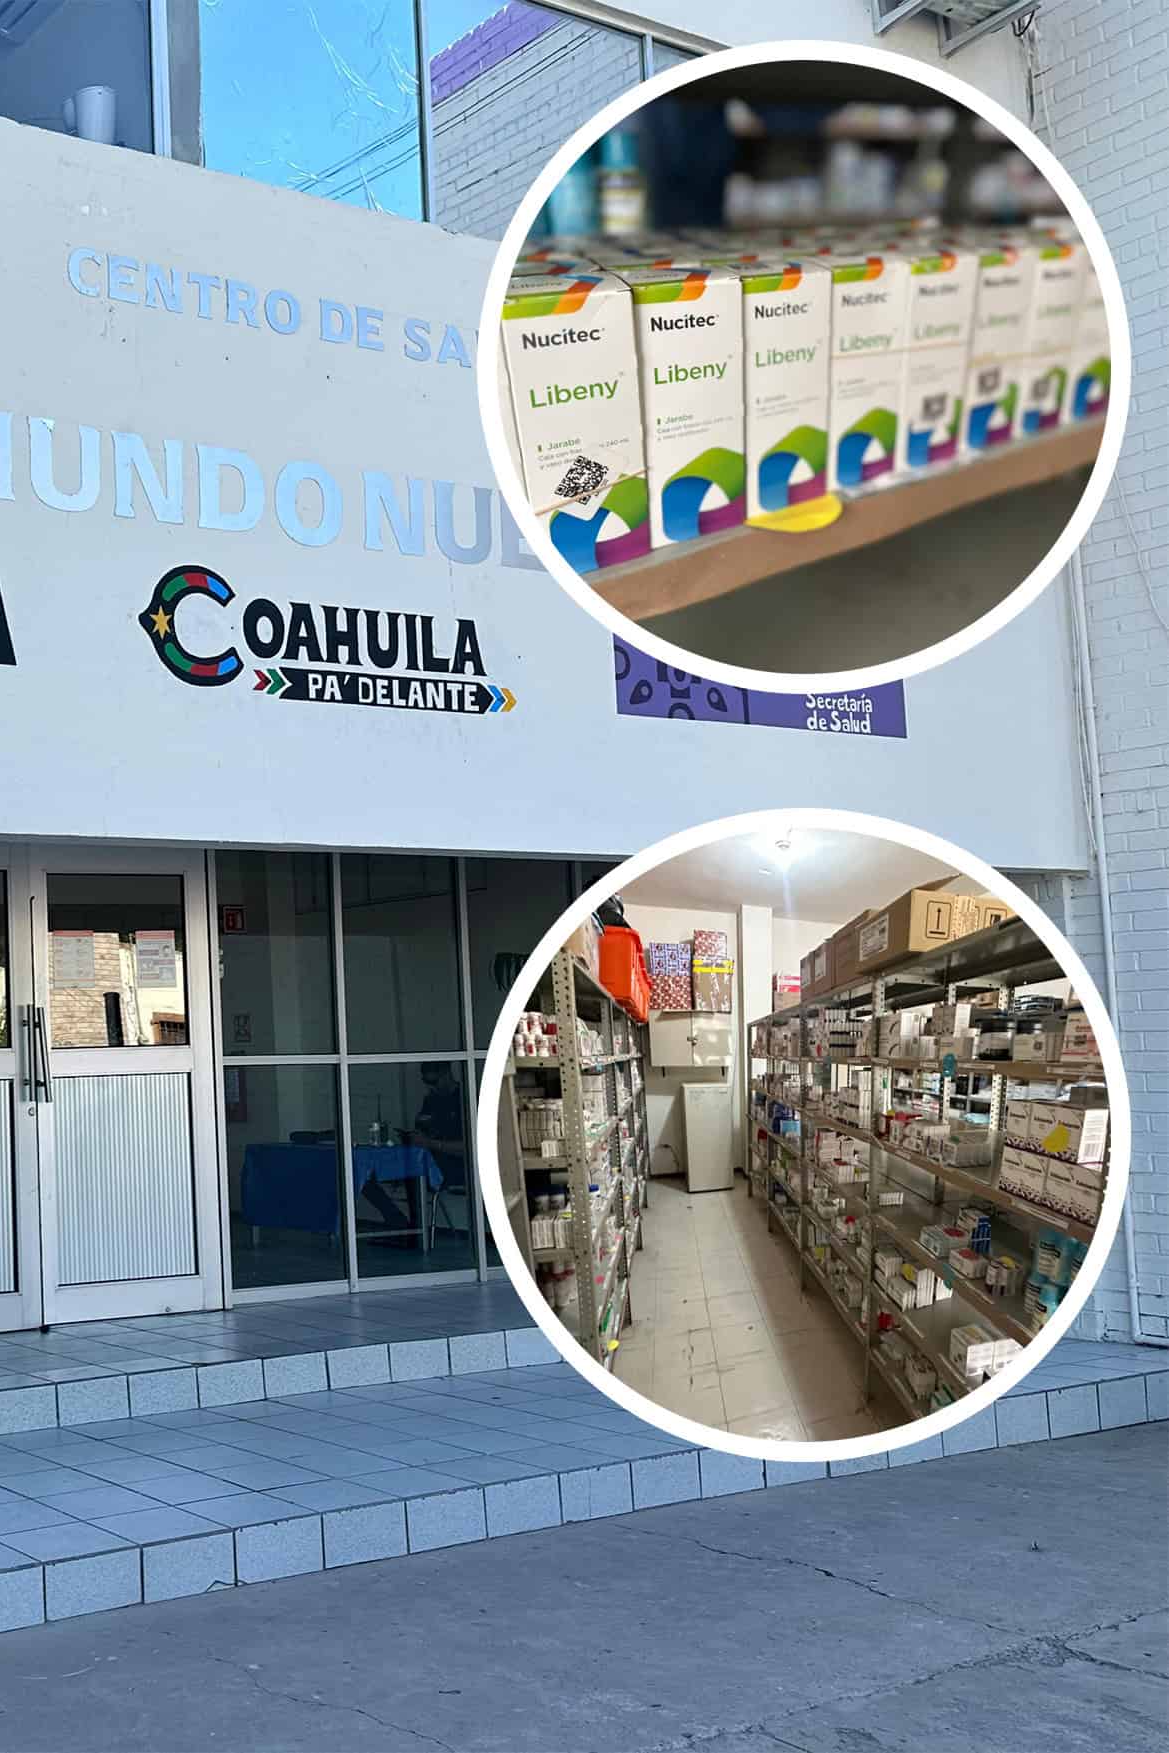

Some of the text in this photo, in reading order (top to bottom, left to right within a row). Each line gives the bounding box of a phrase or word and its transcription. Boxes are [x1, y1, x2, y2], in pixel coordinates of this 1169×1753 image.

[67, 247, 480, 369] CENTRO DE SA
[754, 302, 808, 319] Nucitec
[650, 313, 716, 332] Nucitec
[522, 327, 601, 350] Nucitec
[755, 346, 816, 368] Libeny
[654, 361, 727, 385] Libeny
[529, 379, 619, 409] Libeny
[138, 565, 487, 687] COAHUILA
[358, 676, 480, 712] DELANTE
[805, 693, 873, 712] Secretaría
[806, 709, 872, 734] de Salud
